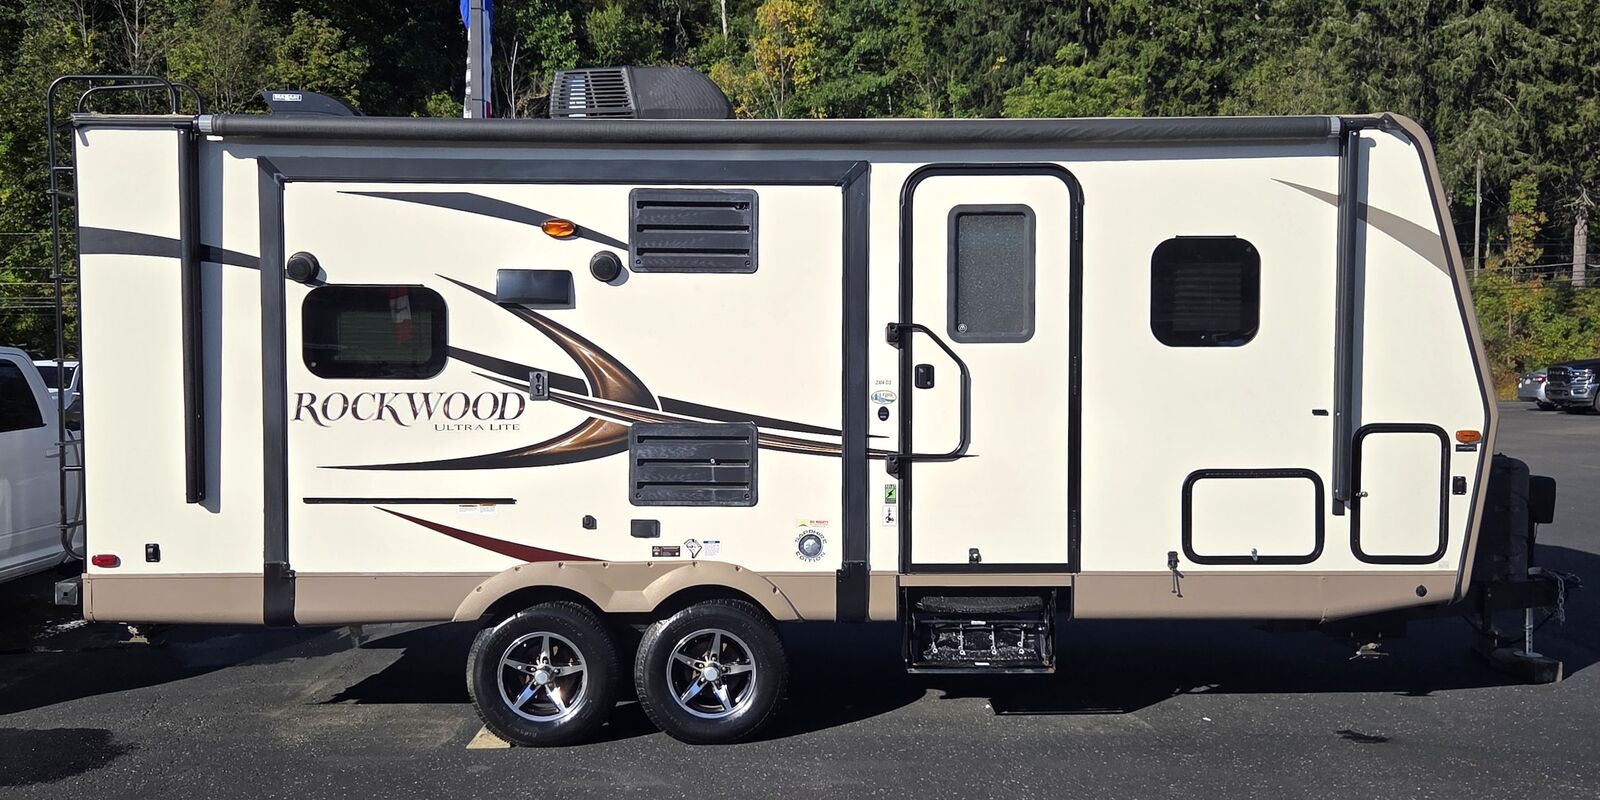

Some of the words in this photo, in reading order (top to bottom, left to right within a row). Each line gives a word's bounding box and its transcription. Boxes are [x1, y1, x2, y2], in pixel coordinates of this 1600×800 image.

[292, 391, 526, 428] ROCKWOOD
[434, 423, 485, 432] ULTRA
[489, 423, 521, 432] LITE
[795, 551, 827, 563] EDITION
